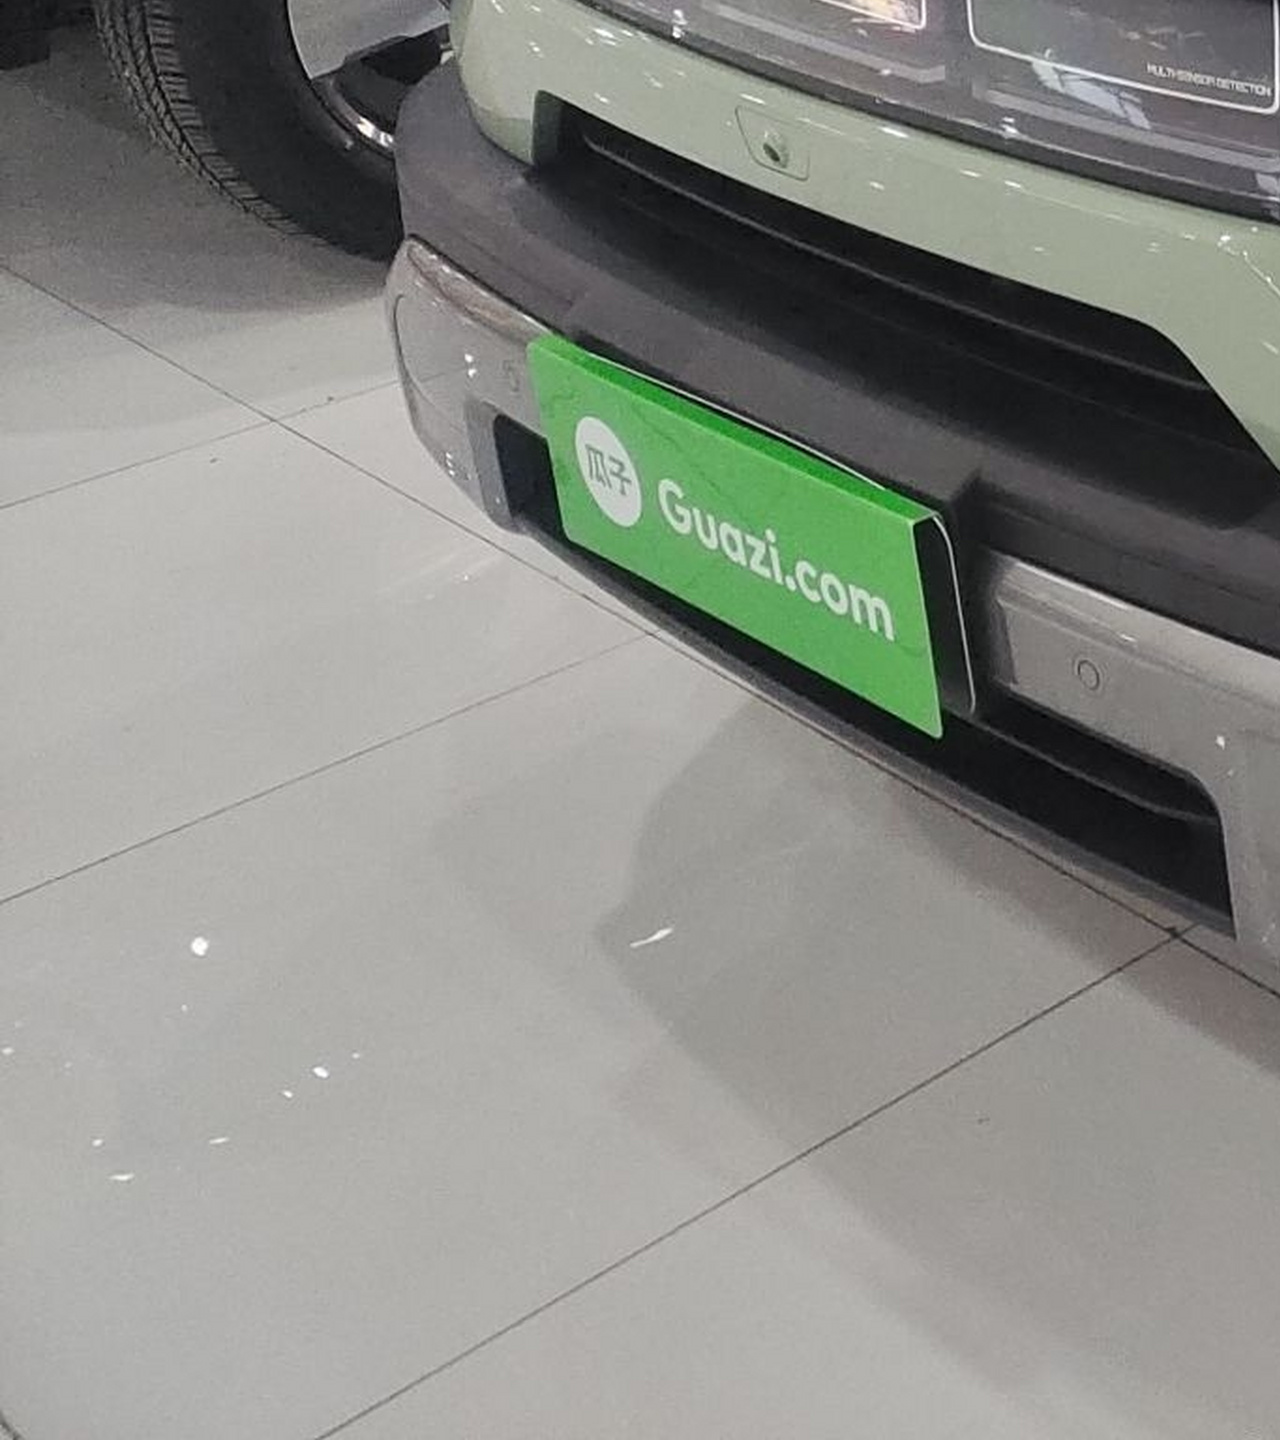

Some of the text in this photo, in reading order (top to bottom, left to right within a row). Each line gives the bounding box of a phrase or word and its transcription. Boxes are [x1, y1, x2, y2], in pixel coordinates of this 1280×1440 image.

[1216, 77, 1272, 97] DETECTION
[585, 443, 632, 496] 瓜子
[657, 478, 895, 643] Guazi.com
